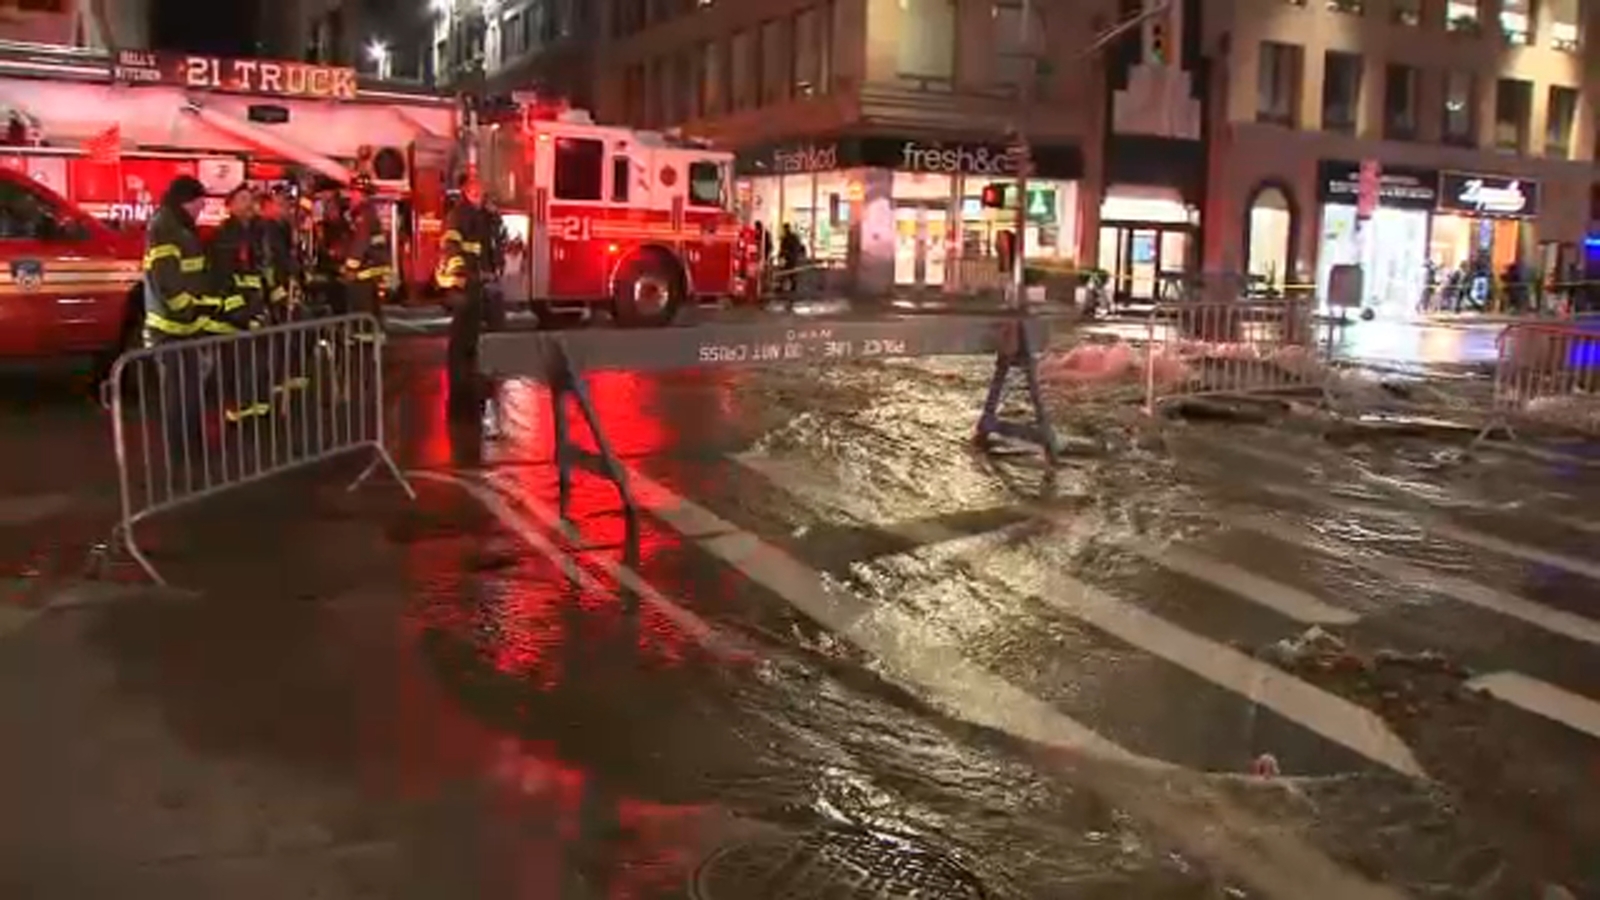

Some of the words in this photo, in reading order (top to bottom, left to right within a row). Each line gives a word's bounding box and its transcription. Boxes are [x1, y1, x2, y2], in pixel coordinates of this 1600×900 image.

[186, 57, 221, 86] 21
[235, 60, 356, 98] TRUCK
[564, 216, 590, 240] 21
[699, 344, 748, 361] CROSS
